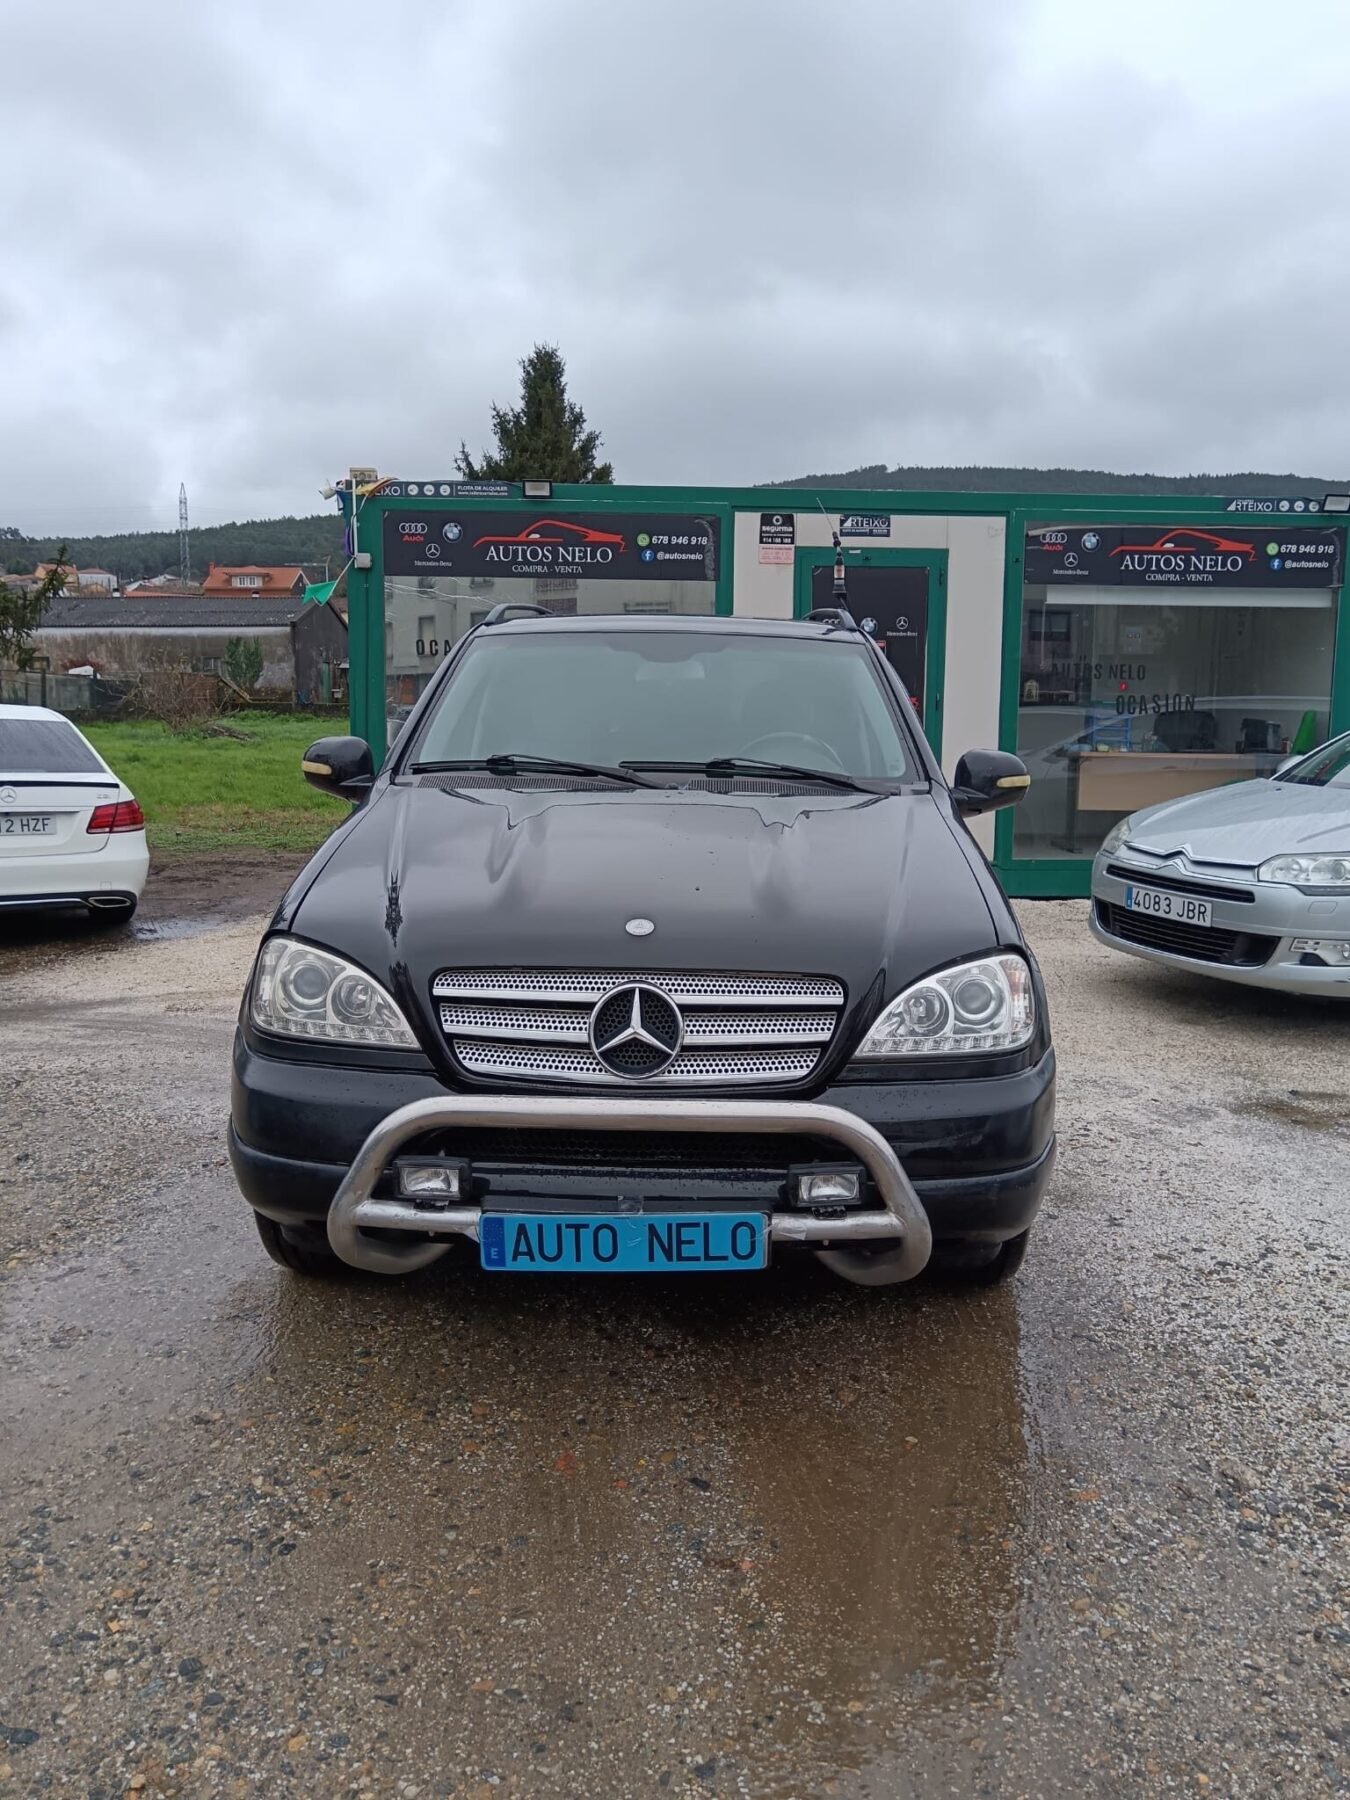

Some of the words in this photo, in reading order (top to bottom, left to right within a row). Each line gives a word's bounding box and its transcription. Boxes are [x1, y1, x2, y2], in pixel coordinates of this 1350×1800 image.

[1227, 499, 1273, 511] ARTEIXO
[651, 535, 669, 544] 678
[670, 535, 689, 545] 946
[690, 536, 708, 545] 918
[485, 545, 553, 563] AUTOS
[557, 546, 613, 564] NELO
[1280, 545, 1297, 553] 678
[1298, 545, 1316, 554] 946
[1318, 545, 1335, 554] 918
[656, 551, 703, 561] @autosnelo
[512, 564, 549, 573] COMPRA
[554, 566, 583, 574] VENTA
[1120, 554, 1185, 571] AUTOS
[1190, 555, 1243, 572] NELO
[1284, 559, 1329, 569] @autosnelo
[1145, 573, 1181, 582] COMPRA
[1186, 574, 1213, 582] VENTA
[1108, 663, 1146, 680] NELO
[20, 817, 51, 833] HZF
[1133, 890, 1172, 915] 4083
[1176, 900, 1208, 923] JBR
[511, 1222, 619, 1263] AUTO
[647, 1221, 757, 1263] NELO
